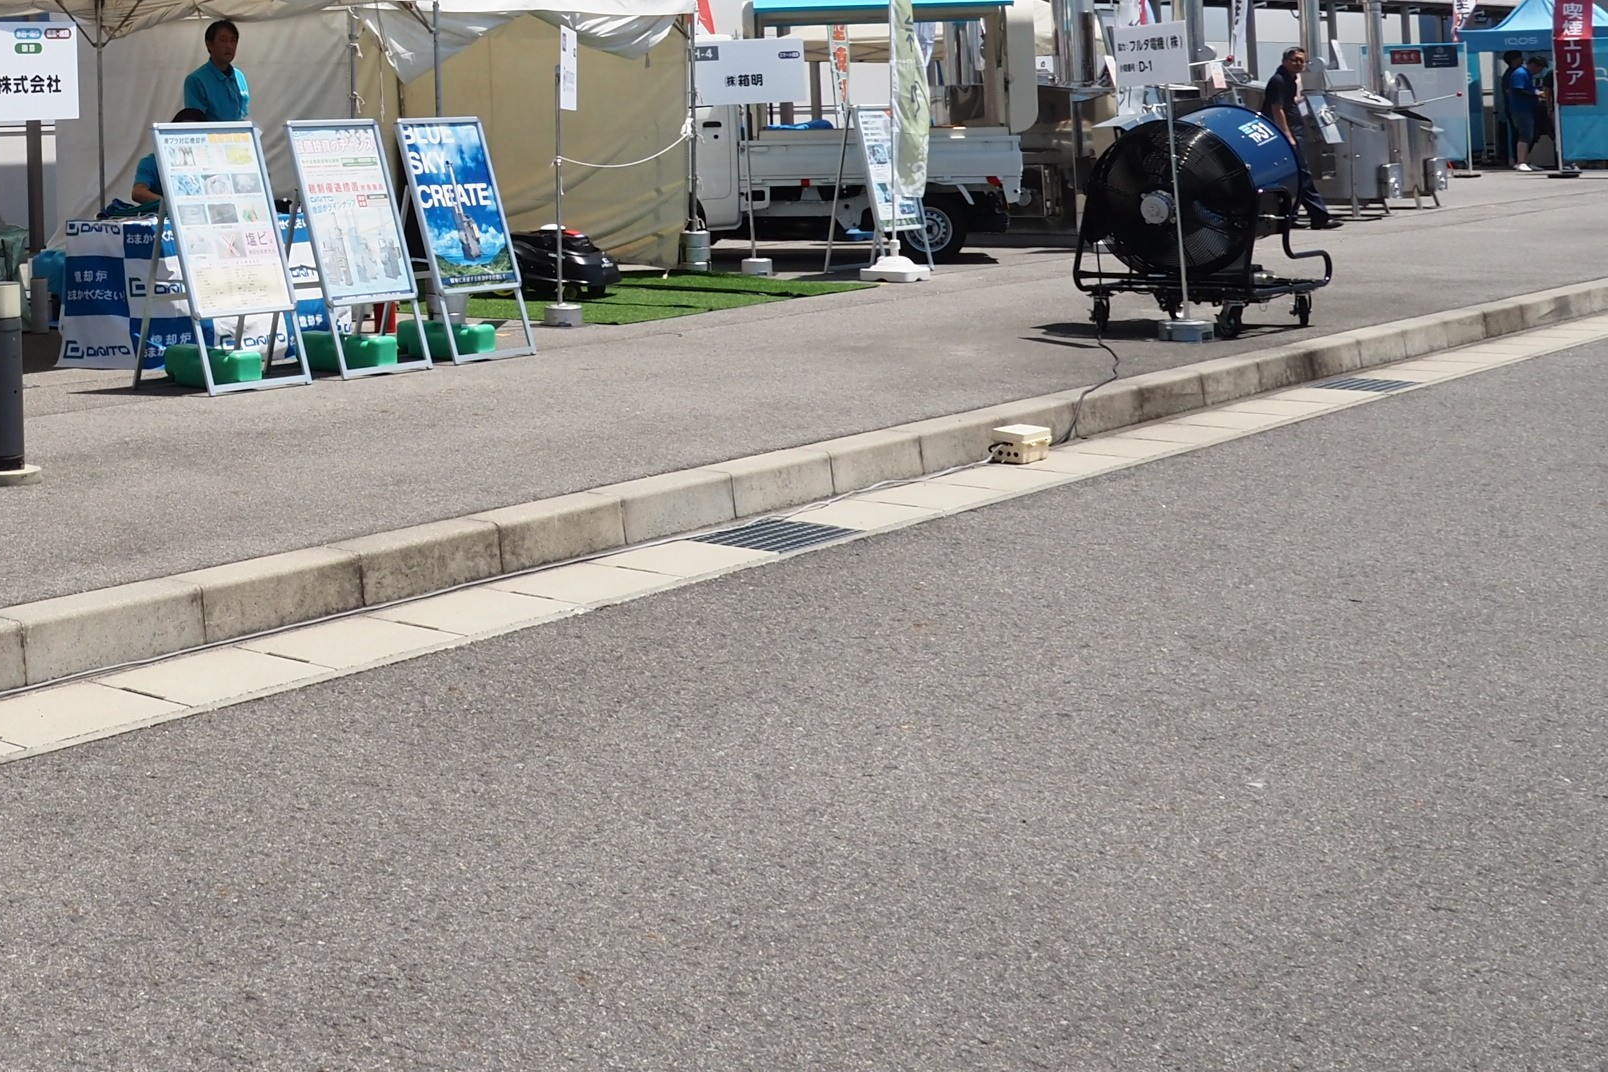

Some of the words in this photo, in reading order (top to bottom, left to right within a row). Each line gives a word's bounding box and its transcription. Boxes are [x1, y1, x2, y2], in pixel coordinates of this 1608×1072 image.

[1504, 36, 1539, 46] IQOS
[1562, 3, 1584, 85] 喫煙エリア
[403, 124, 455, 145] BLUE
[409, 151, 446, 175] SKY
[418, 183, 492, 209] CREATE
[80, 222, 121, 235] DAITO
[86, 345, 131, 357] DAITO
